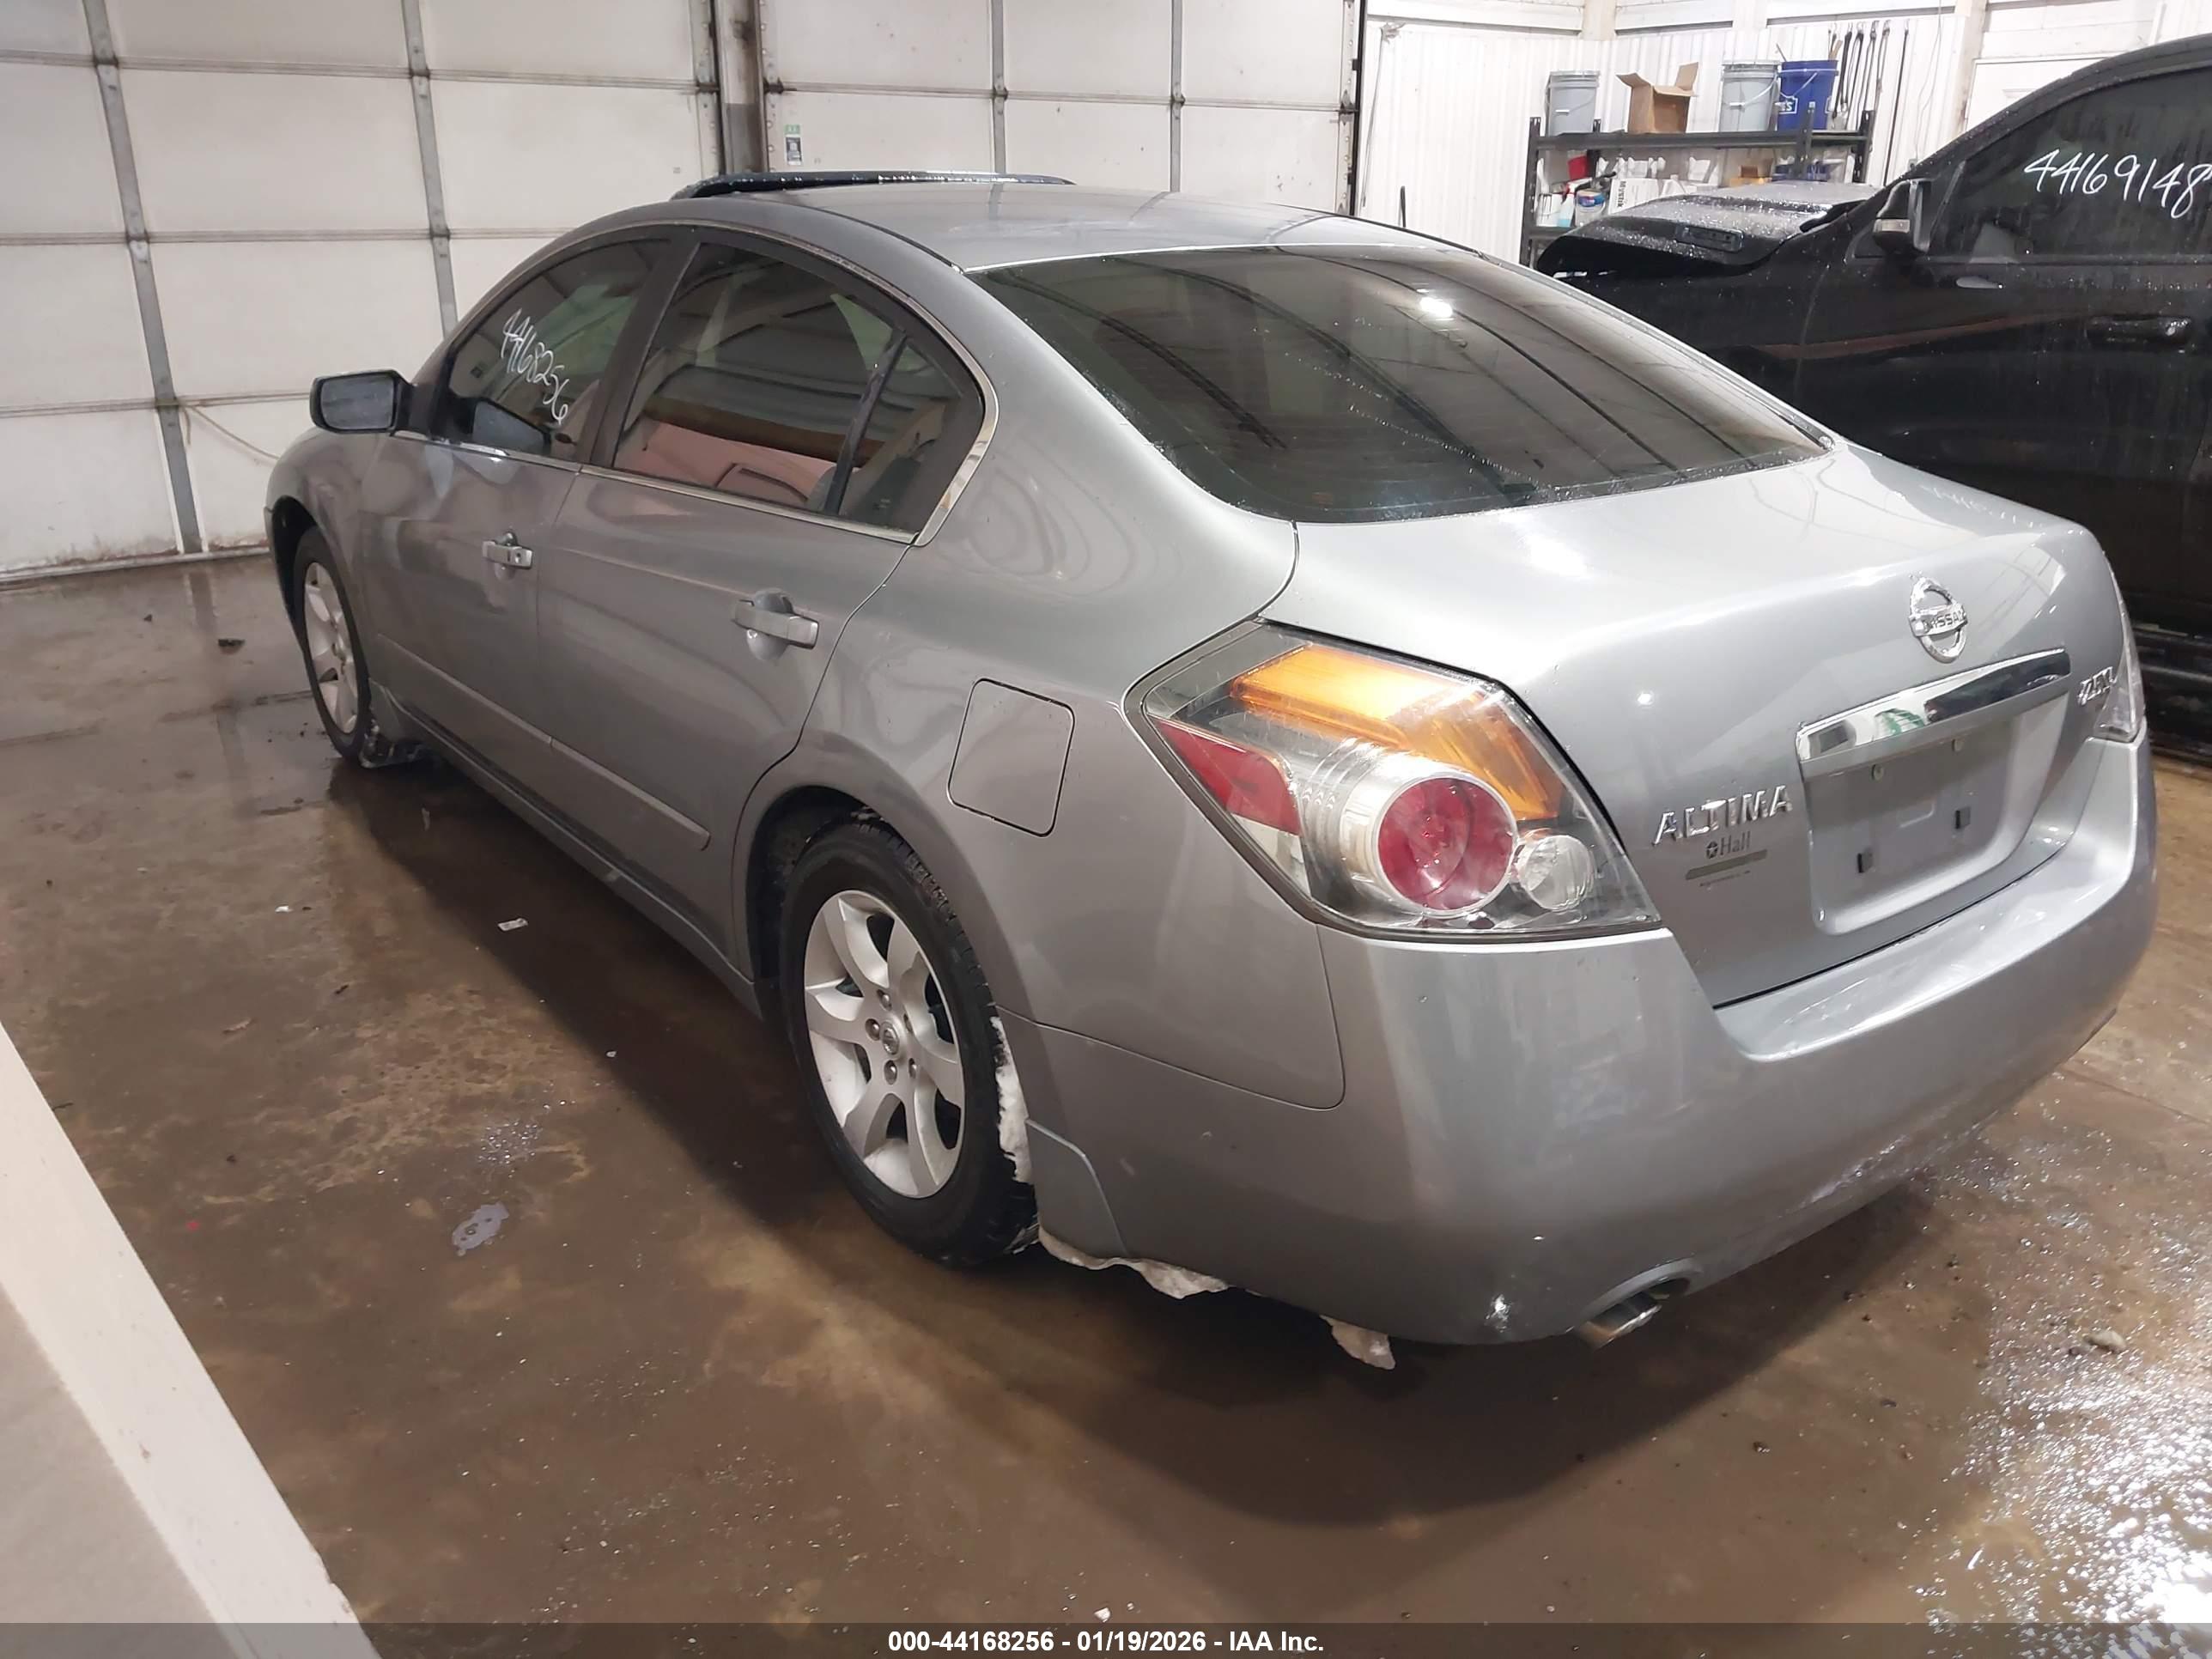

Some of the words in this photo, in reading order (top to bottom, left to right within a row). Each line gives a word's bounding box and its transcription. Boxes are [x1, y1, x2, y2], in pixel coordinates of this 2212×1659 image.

[2024, 149, 2212, 219] 44169148
[501, 307, 570, 426] 44168256
[1651, 785, 1794, 847] ALTIMA
[1719, 830, 1751, 856] Hall
